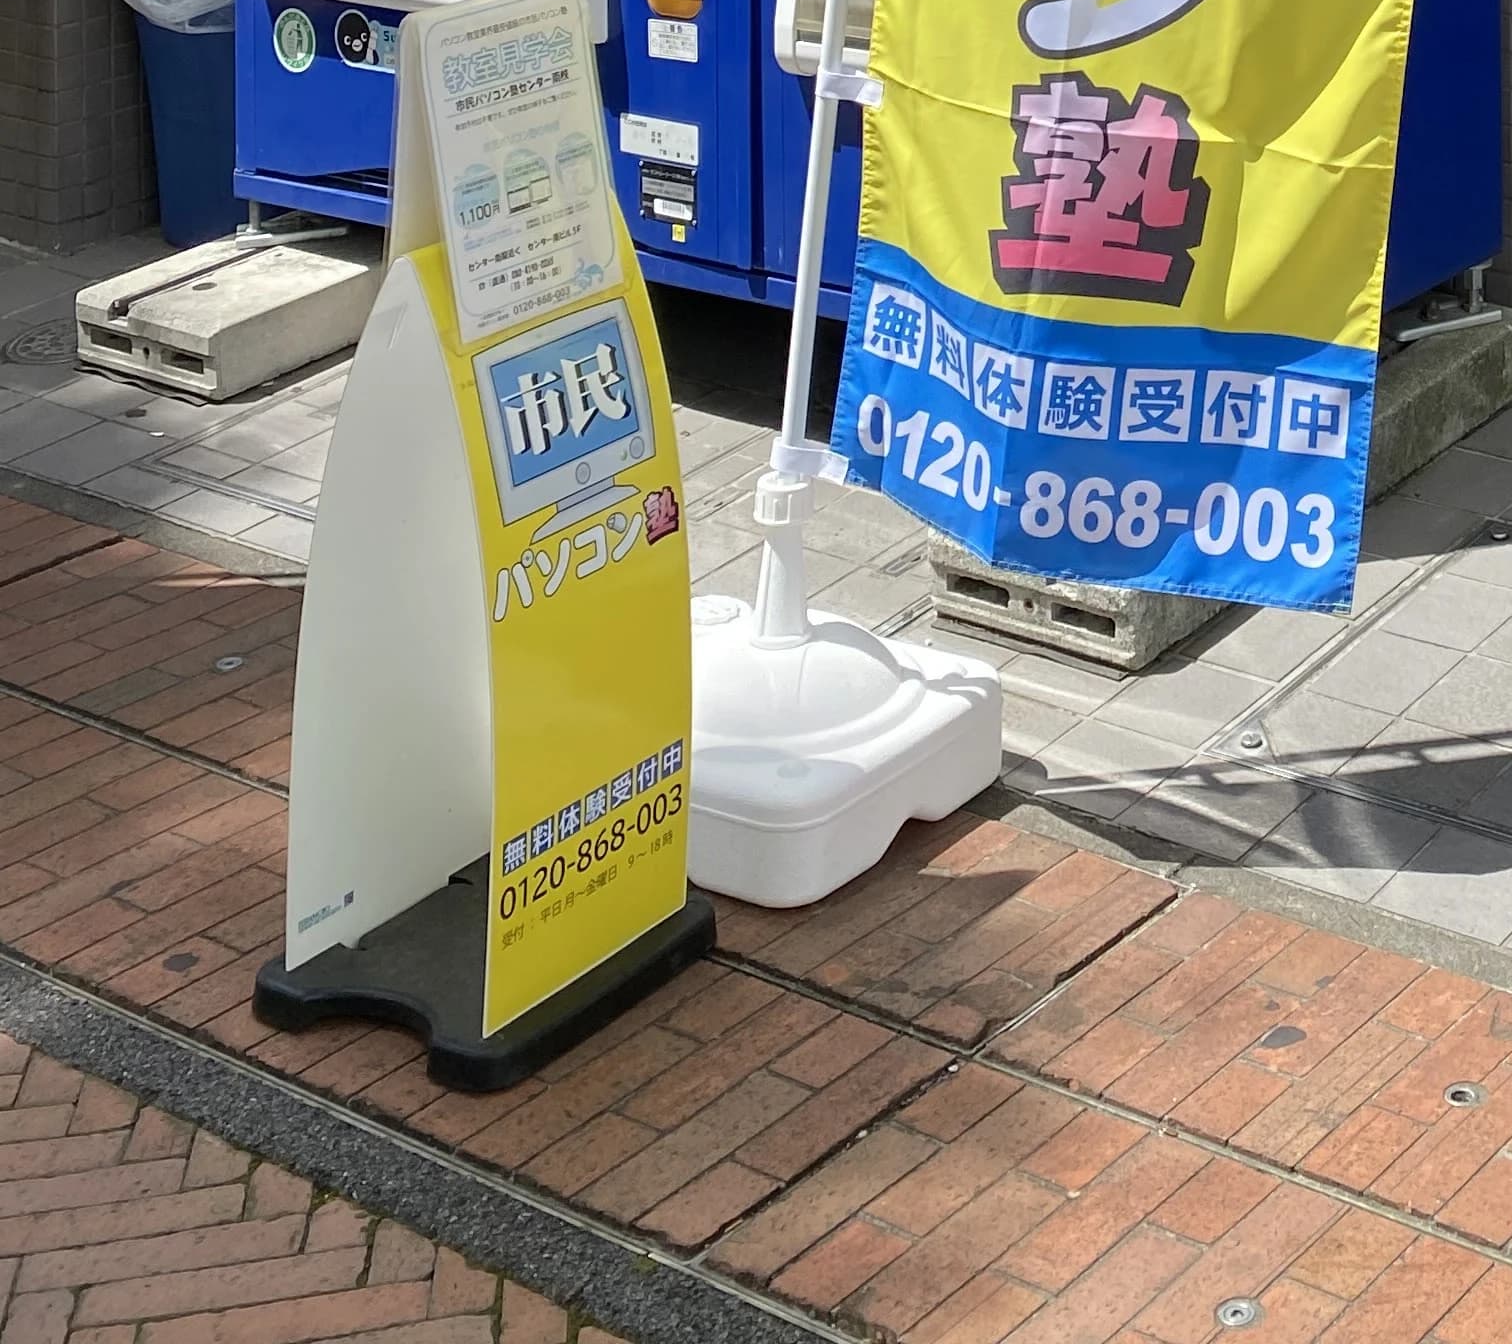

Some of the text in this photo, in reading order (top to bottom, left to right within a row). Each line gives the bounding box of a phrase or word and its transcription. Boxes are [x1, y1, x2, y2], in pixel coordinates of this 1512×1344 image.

[442, 25, 574, 95] 教室見学会
[500, 342, 632, 456] 市民
[867, 288, 1345, 454] 無料体験受付中
[856, 393, 1337, 570] 0120-868-003
[492, 485, 680, 623] パソコン塾
[499, 782, 683, 921] 0120-868-003
[503, 742, 682, 875] 無料体験受付中
